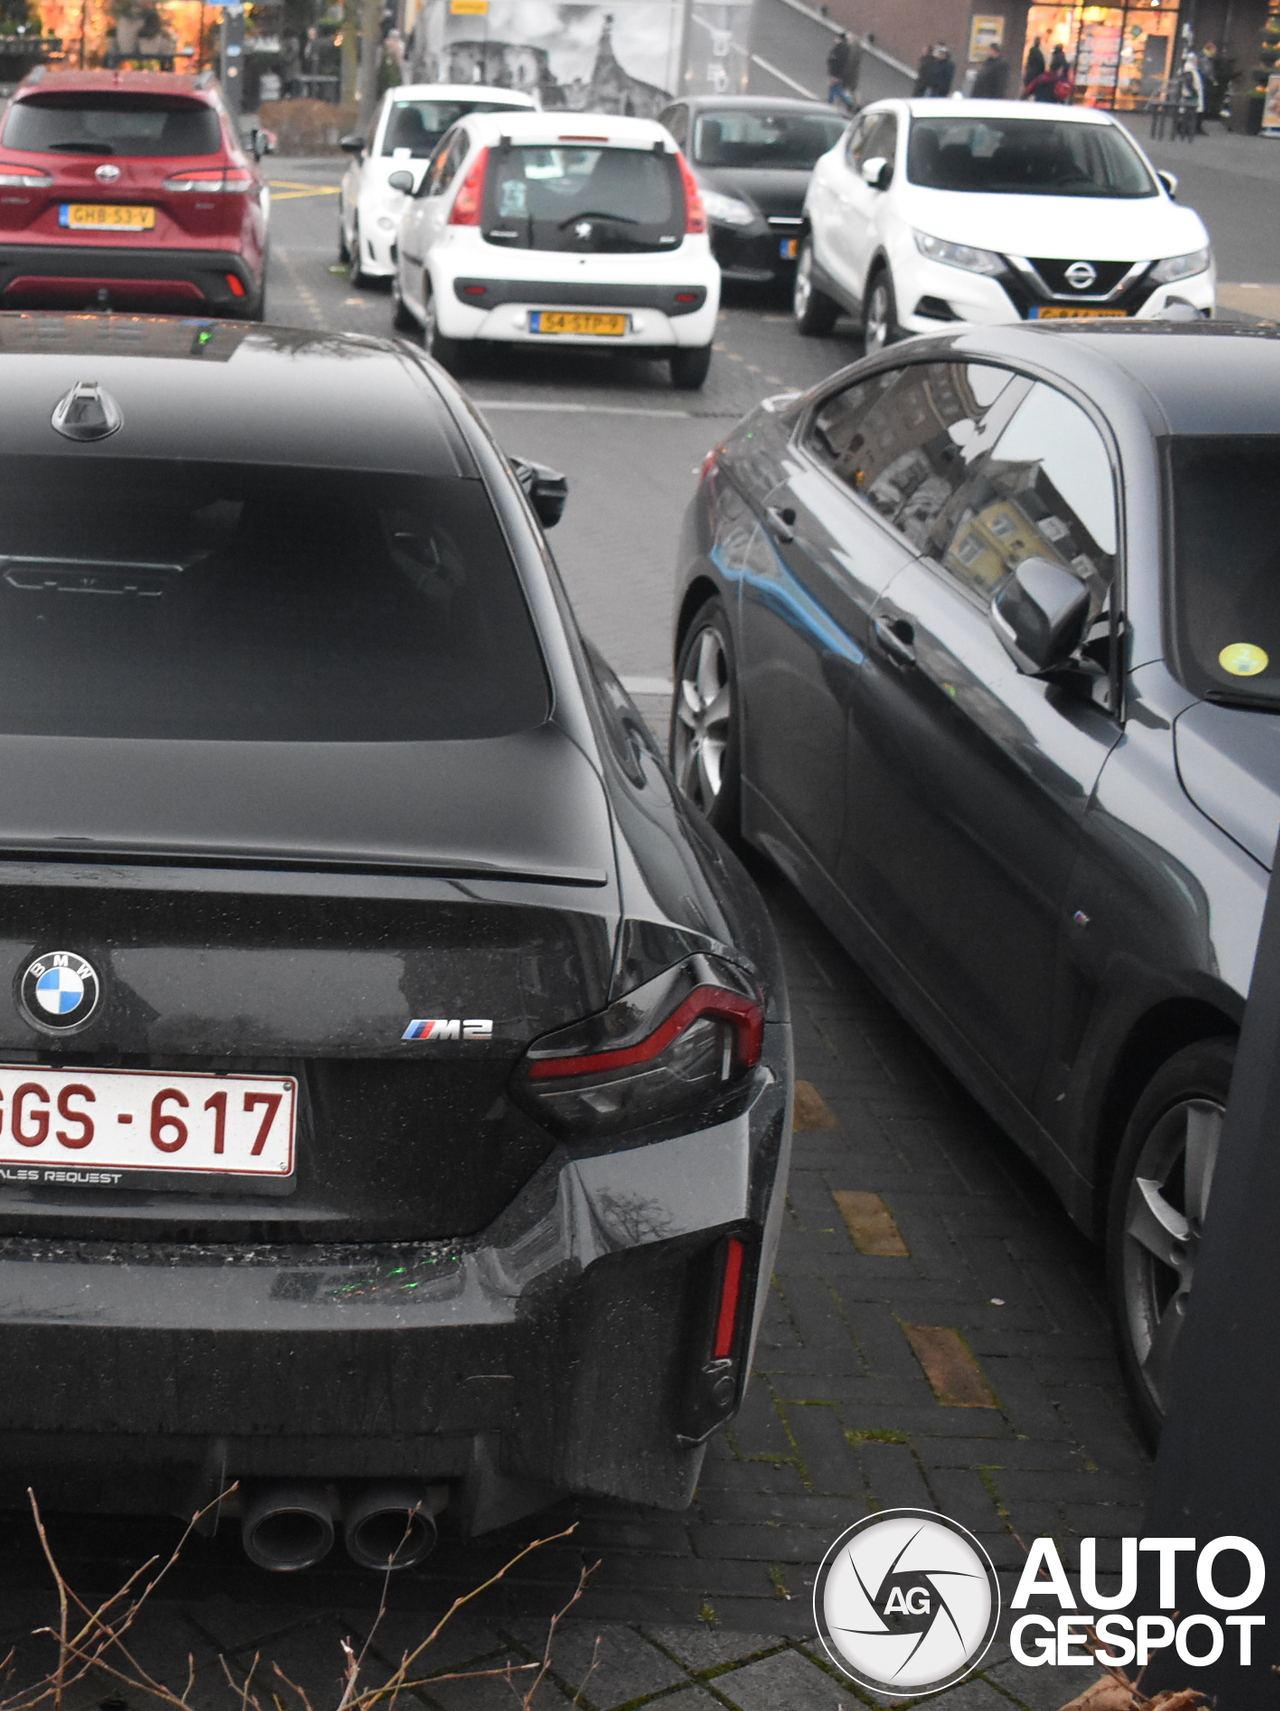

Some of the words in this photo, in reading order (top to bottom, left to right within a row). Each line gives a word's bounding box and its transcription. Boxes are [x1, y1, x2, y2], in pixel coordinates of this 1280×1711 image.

[29, 954, 93, 981] BMW
[418, 1019, 494, 1040] M2
[44, 1170, 123, 1184] REQUEST
